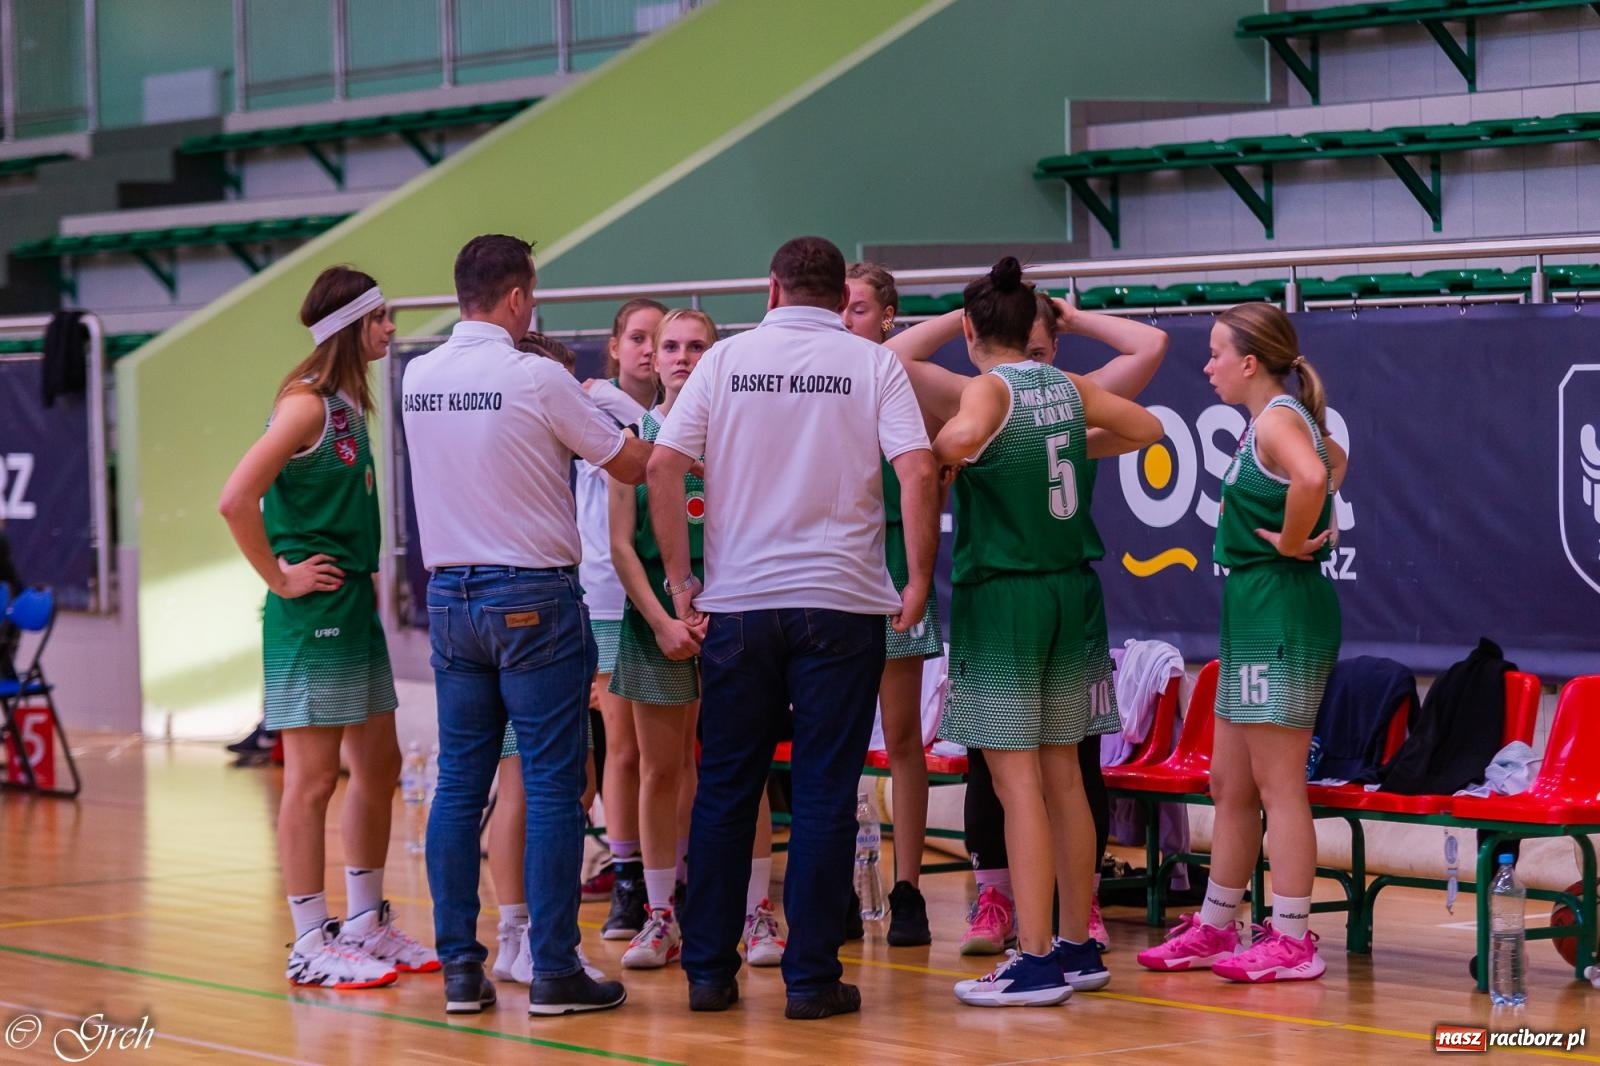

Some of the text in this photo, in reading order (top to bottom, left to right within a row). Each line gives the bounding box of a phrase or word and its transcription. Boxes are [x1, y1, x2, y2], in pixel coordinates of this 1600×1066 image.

[731, 374, 852, 396] BASKET KŁODZKO
[403, 392, 502, 412] BASKET KŁODZKO
[1045, 430, 1079, 520] 5
[1238, 663, 1270, 705] 15
